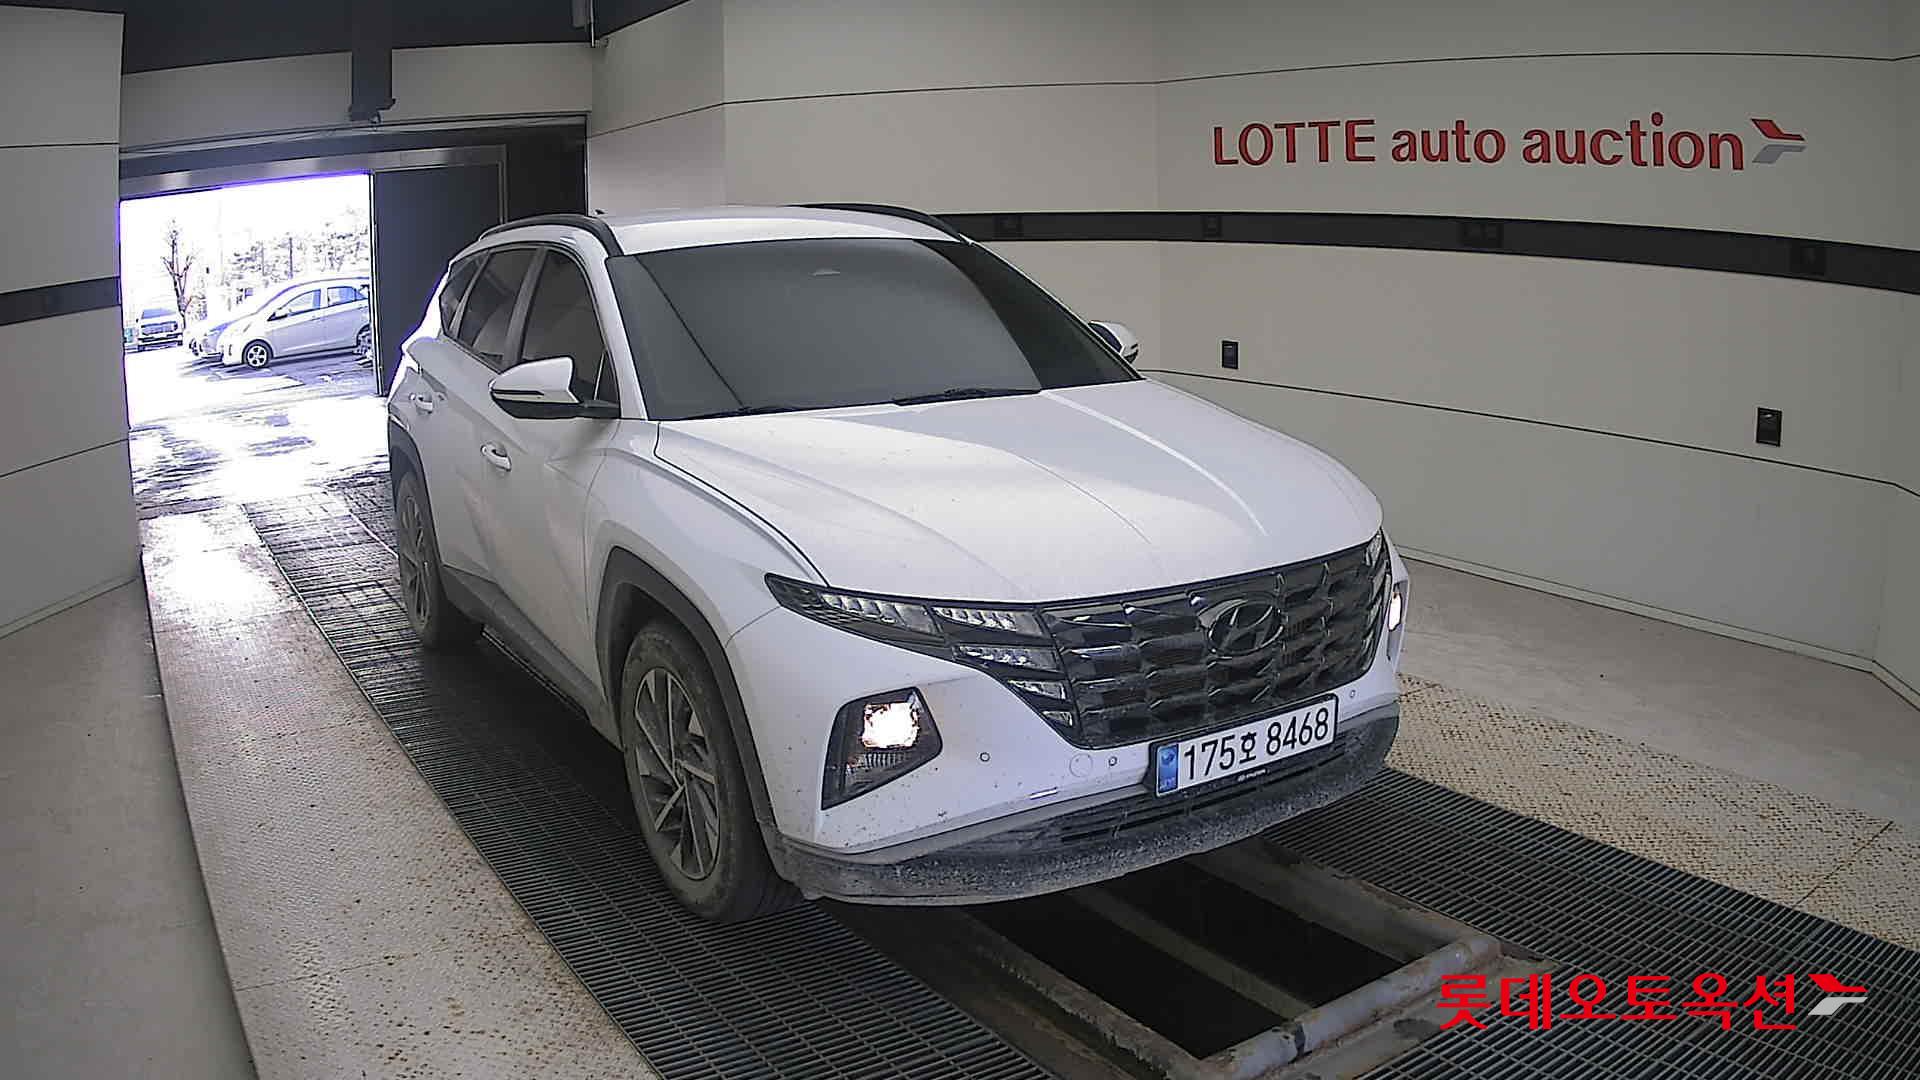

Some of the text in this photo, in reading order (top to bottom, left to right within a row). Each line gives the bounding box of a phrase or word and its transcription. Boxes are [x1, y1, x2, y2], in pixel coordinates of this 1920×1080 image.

[1213, 112, 1744, 170] LOTTE auto auction
[1184, 707, 1329, 780] 175호 8468
